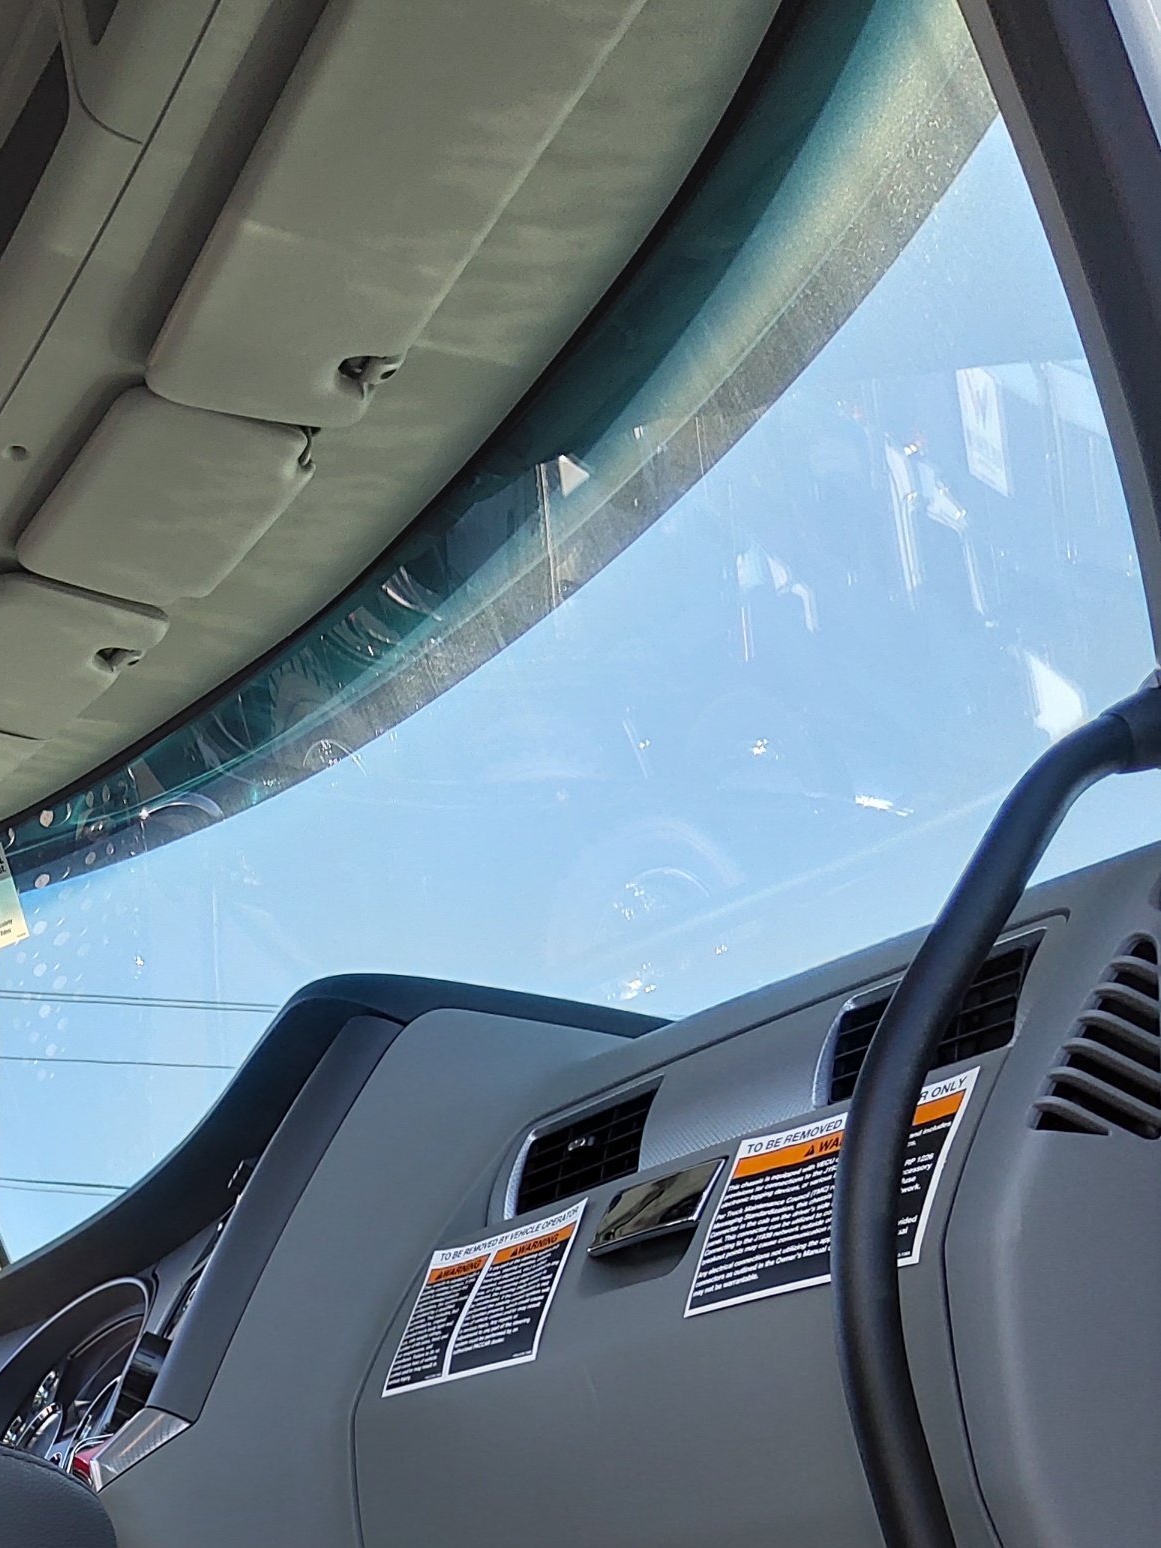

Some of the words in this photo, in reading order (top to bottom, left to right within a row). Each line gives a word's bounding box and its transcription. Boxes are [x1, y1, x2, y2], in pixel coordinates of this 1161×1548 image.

[747, 1142, 763, 1154] TO
[765, 1138, 781, 1150] BE
[783, 1119, 843, 1145] REMOVED
[931, 1075, 967, 1098] ONLY
[440, 1251, 451, 1261] TO
[451, 1250, 464, 1259] BE
[463, 1238, 499, 1256] REMOVED
[497, 1234, 509, 1244] BY
[509, 1223, 541, 1241] VEHICLE
[541, 1206, 579, 1230] OPERATOR
